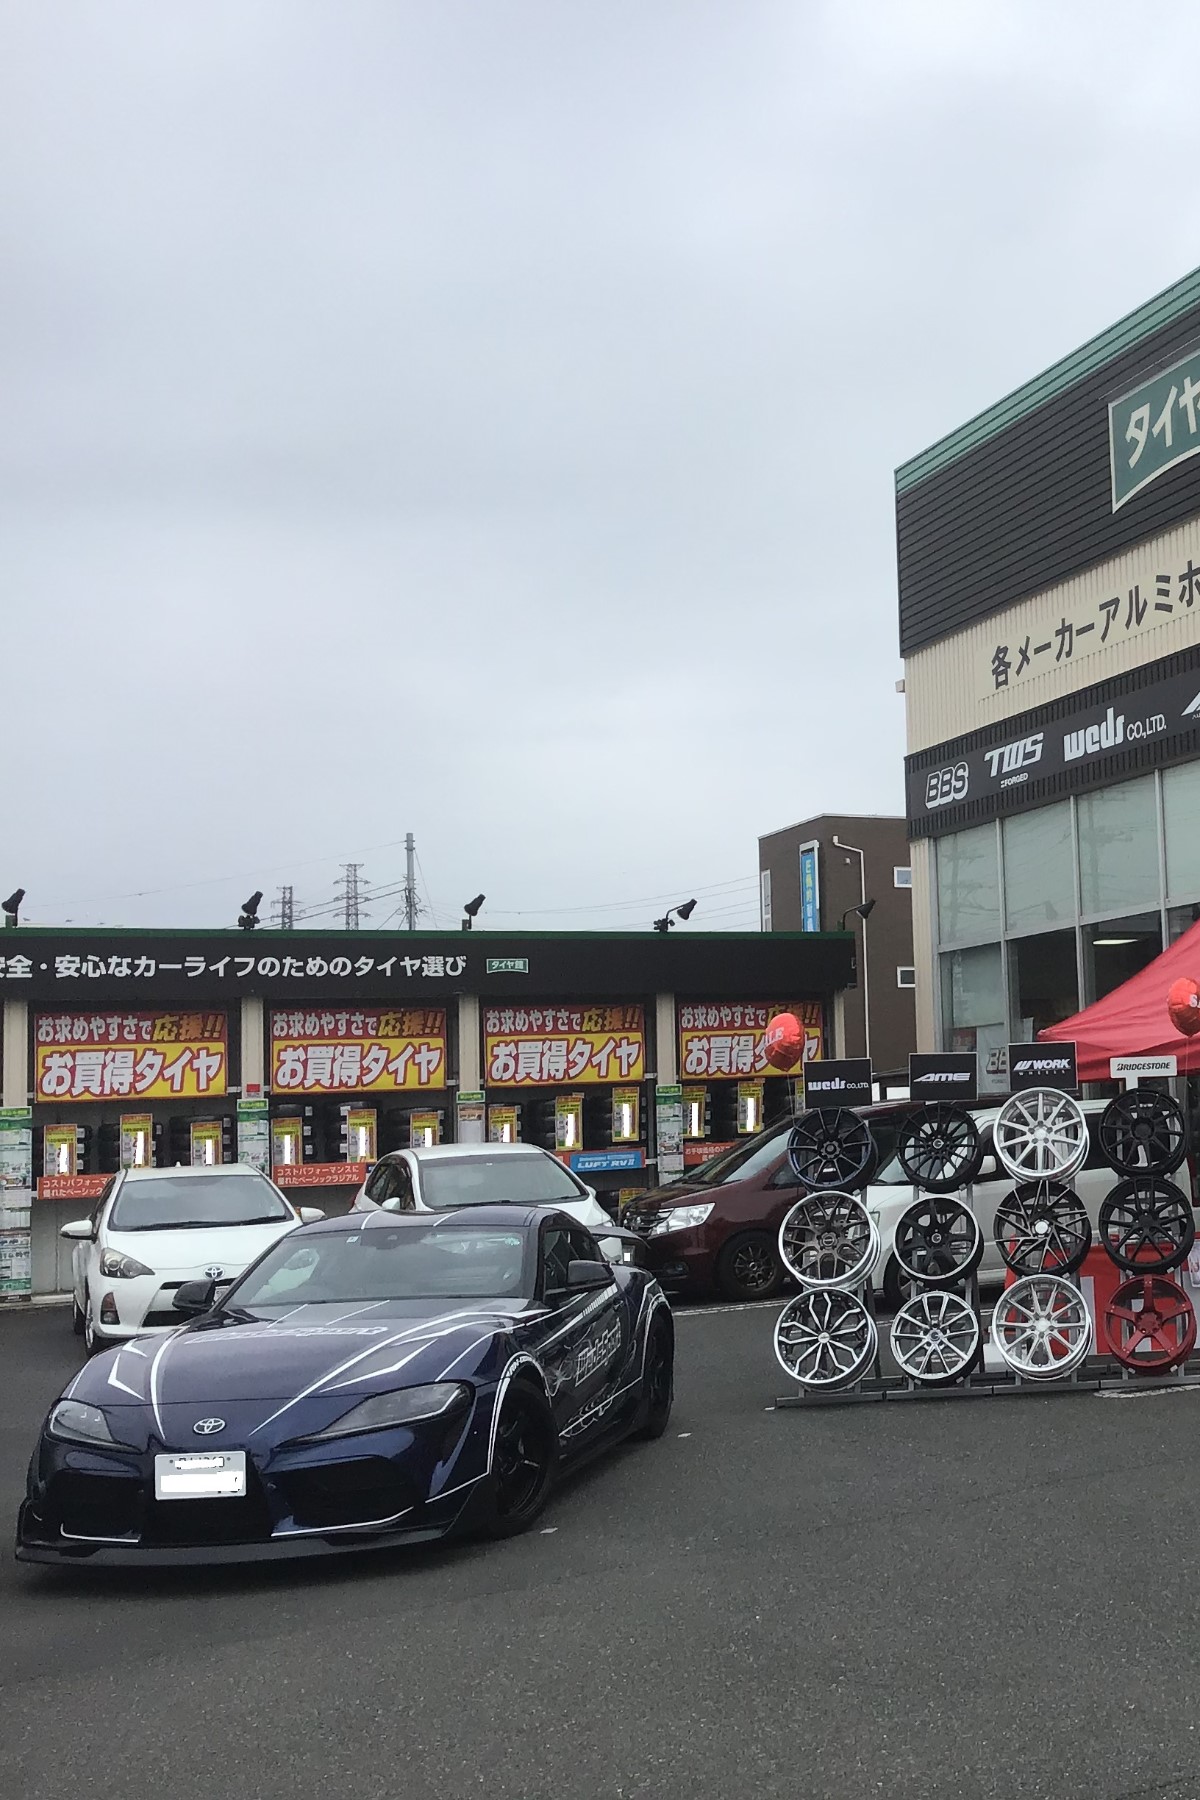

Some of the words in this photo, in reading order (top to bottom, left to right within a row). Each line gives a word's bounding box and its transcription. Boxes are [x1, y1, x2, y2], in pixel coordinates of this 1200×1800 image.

[984, 732, 1044, 778] TWS
[925, 761, 969, 811] BBS
[0, 954, 467, 979] 全・安心なカーライフのためのタイヤ選び
[38, 1014, 223, 1043] お求めやすさで応援!!
[273, 1011, 443, 1040] お求めやすさで応援!!
[486, 1006, 640, 1034] お求めやすさで応援!!
[42, 1048, 223, 1097] お買得タイヤ
[277, 1044, 443, 1089] お買得タイヤ
[491, 1037, 640, 1080] お買得タイヤ
[1117, 1061, 1171, 1071] BRIDGESTONE
[914, 1072, 971, 1083] AME
[277, 1166, 359, 1176] コストパフォーマンスに
